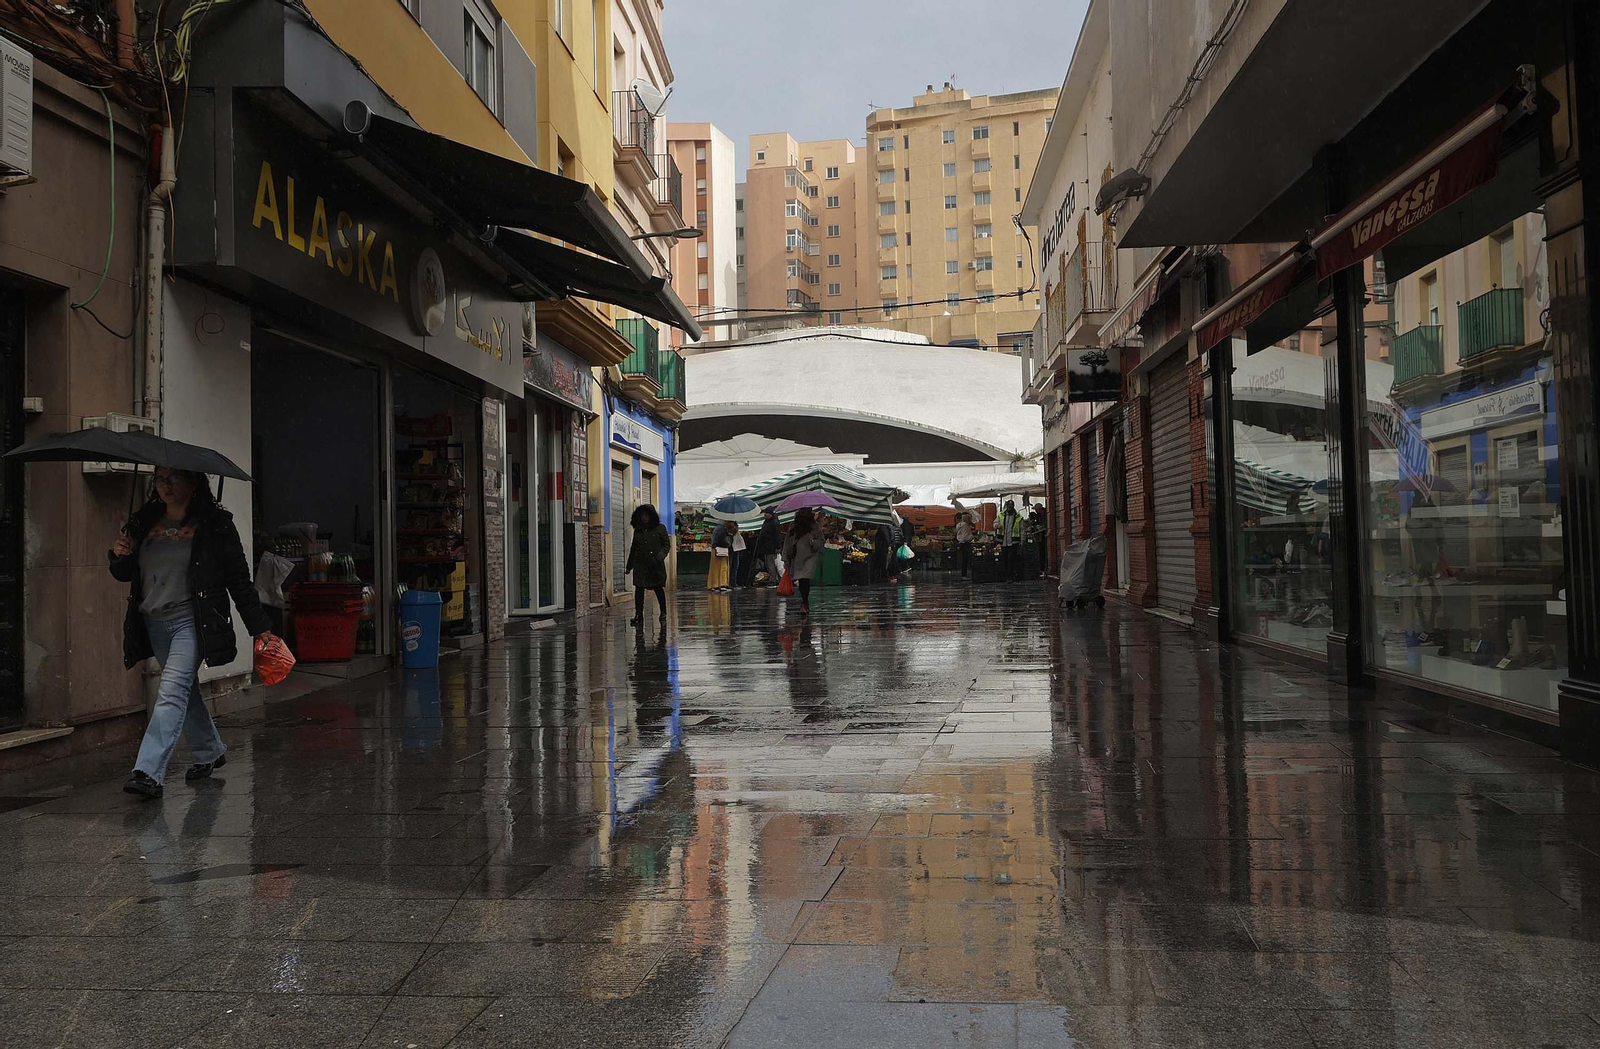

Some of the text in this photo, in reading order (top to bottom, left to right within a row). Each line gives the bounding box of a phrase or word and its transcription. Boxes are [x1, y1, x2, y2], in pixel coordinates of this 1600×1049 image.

[252, 159, 399, 304] ALASKA
[1055, 181, 1076, 246] barrera
[1350, 169, 1441, 250] Vanessa
[1396, 199, 1435, 232] CALZADOS
[1248, 366, 1285, 394] Vanessa
